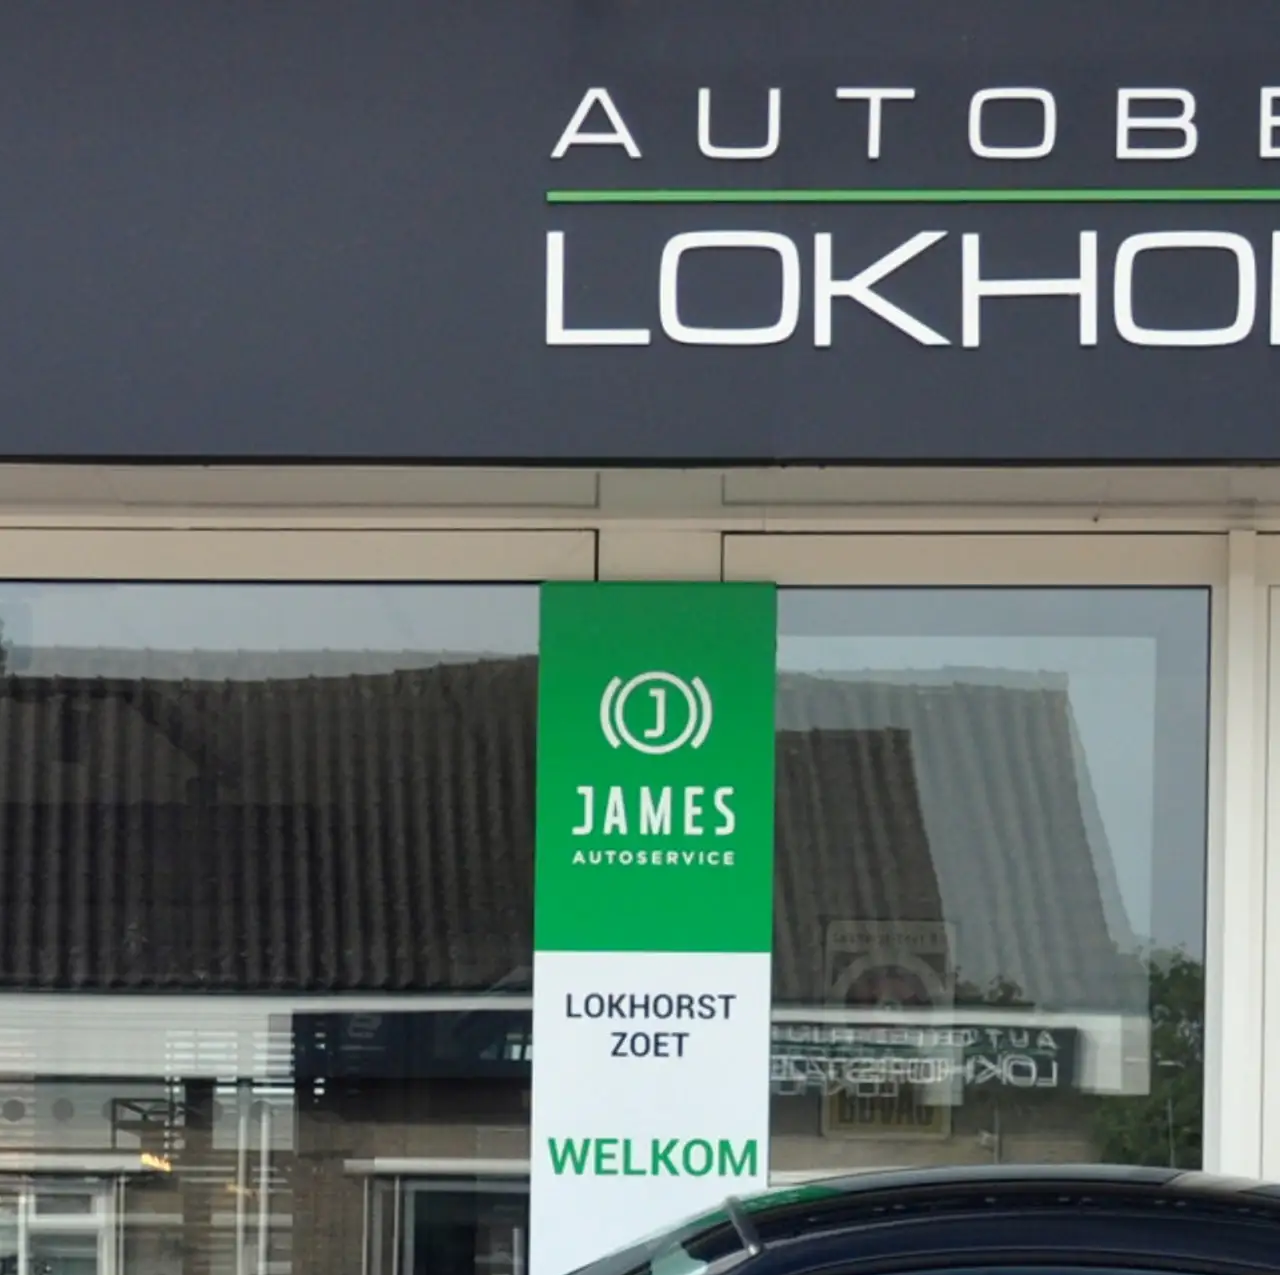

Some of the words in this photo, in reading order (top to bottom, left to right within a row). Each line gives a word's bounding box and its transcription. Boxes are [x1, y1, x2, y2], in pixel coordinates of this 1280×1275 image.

[571, 785, 736, 836] JAMES
[572, 849, 735, 866] AUTOSERVICE
[566, 993, 737, 1020] LOKHORST
[611, 1031, 690, 1058] ZOET
[547, 1137, 758, 1177] WELKOM
